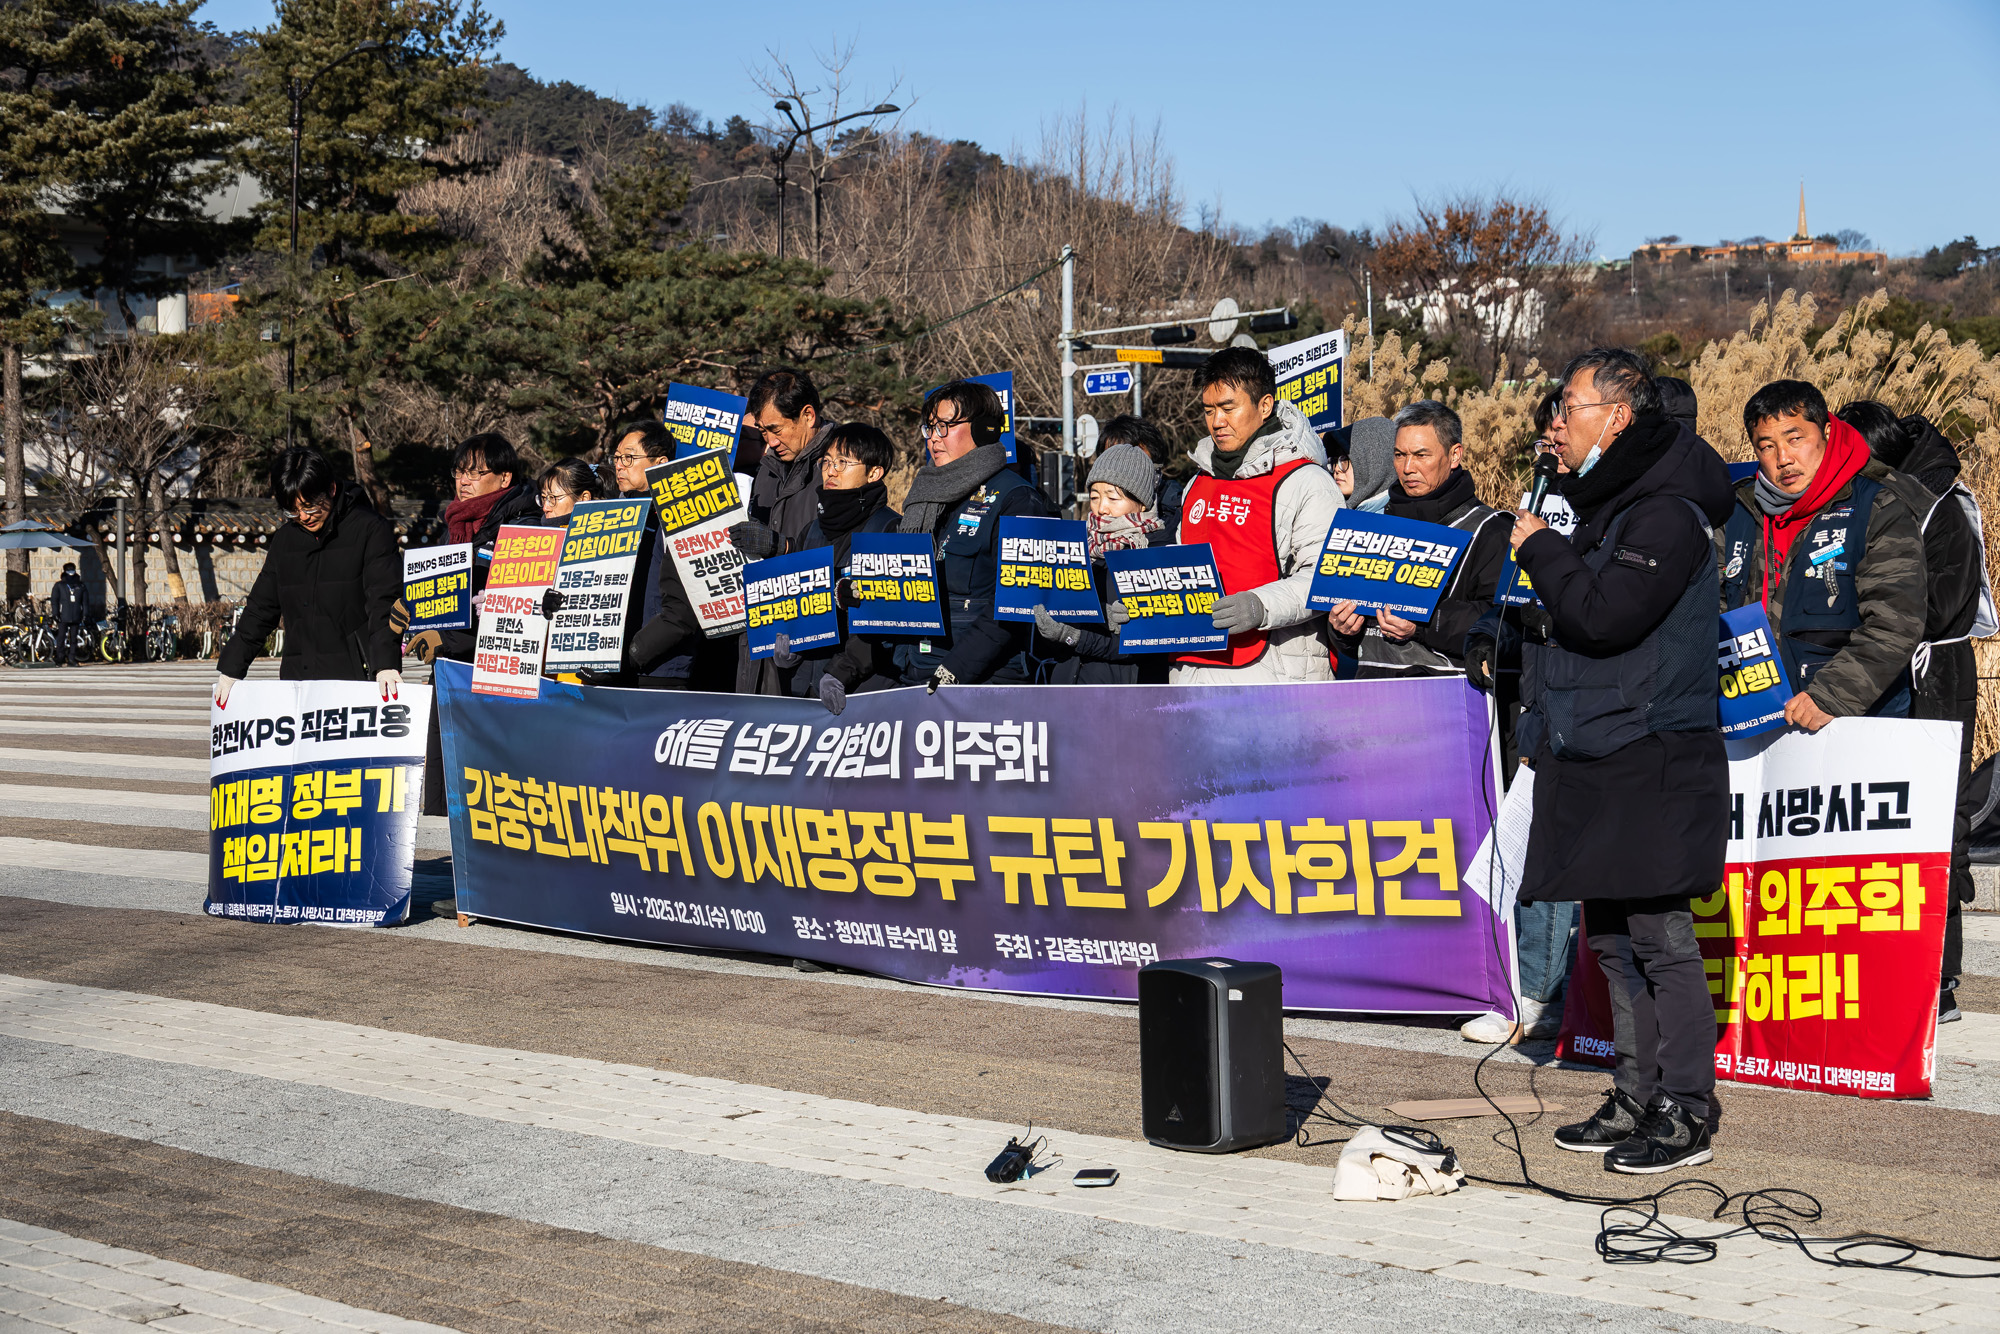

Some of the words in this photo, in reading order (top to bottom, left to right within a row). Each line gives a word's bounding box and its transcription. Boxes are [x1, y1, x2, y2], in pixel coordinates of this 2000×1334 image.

[1306, 339, 1338, 362] 직접고용
[1304, 364, 1338, 394] 정부가
[666, 400, 740, 434] 발전비정규직
[696, 430, 734, 454] 이행!
[651, 456, 726, 506] 김충현의
[569, 506, 642, 536] 김용균의
[660, 481, 740, 532] 외침이다!
[1206, 501, 1250, 526] 노동당
[494, 534, 557, 560] 김충현의
[563, 530, 641, 562] 외침이다!
[1001, 538, 1086, 565] 발전비정규직
[1326, 528, 1458, 567] 발전비정규직
[408, 558, 437, 575] 한전KPS
[438, 551, 467, 568] 직접고용
[489, 560, 556, 584] 외침이다!
[689, 548, 749, 578] 경상정비
[852, 553, 932, 578] 발전비정규직
[1000, 564, 1053, 588] 정규직화
[1056, 568, 1091, 590] 이행!
[1319, 553, 1395, 581] 정규직화
[1395, 564, 1446, 588] 이행!
[406, 579, 434, 602] 이재명
[436, 572, 468, 595] 정부가
[559, 570, 602, 588] 김용균의
[604, 573, 628, 586] 동료인
[746, 566, 831, 605] 발전비정규직
[903, 580, 936, 602] 이행!
[1114, 564, 1217, 594] 발전비정규직
[415, 595, 458, 619] 책임져라!
[555, 613, 591, 628] 운전분야
[592, 613, 621, 627] 노동자
[748, 598, 798, 628] 정규직화
[800, 592, 832, 616] 이행!
[1122, 594, 1184, 618] 정규직화
[496, 617, 524, 634] 발전소
[479, 635, 511, 652] 비정규직
[512, 638, 540, 654] 노동자
[551, 632, 620, 652] 직접고용하라!
[476, 653, 538, 676] 직접고용하라!
[1719, 659, 1781, 699] 이행!
[212, 716, 295, 759] 한전KPS
[301, 704, 411, 742] 직접고용
[655, 718, 734, 770] 해를
[728, 722, 811, 776] 넘긴
[805, 719, 903, 779] 위험의
[913, 720, 1049, 782] 외주화!
[210, 775, 283, 831] 이재명
[292, 766, 410, 820] 정부가
[1756, 781, 1911, 839] 사망사고
[223, 826, 362, 884] 책임져라!
[464, 767, 695, 876] 김충현대책위
[697, 801, 976, 901] 이재명정부
[988, 816, 1126, 909] 규탄
[1138, 817, 1462, 917] 기자회견
[276, 905, 299, 918] 노동자
[300, 906, 334, 921] 사망사고
[335, 908, 386, 922] 대책위원회
[1758, 862, 1926, 936] 외주화
[643, 897, 730, 930] 2025.12.31.(수)
[730, 908, 766, 934] 10:00
[834, 919, 885, 947] 청와대
[885, 924, 937, 953] 분수대
[938, 929, 958, 954] 앞
[1044, 936, 1159, 967] 김충현대책위
[1736, 1054, 1770, 1078] 노동자
[1771, 1060, 1821, 1084] 사망사고
[1824, 1066, 1895, 1093] 대책위원회
